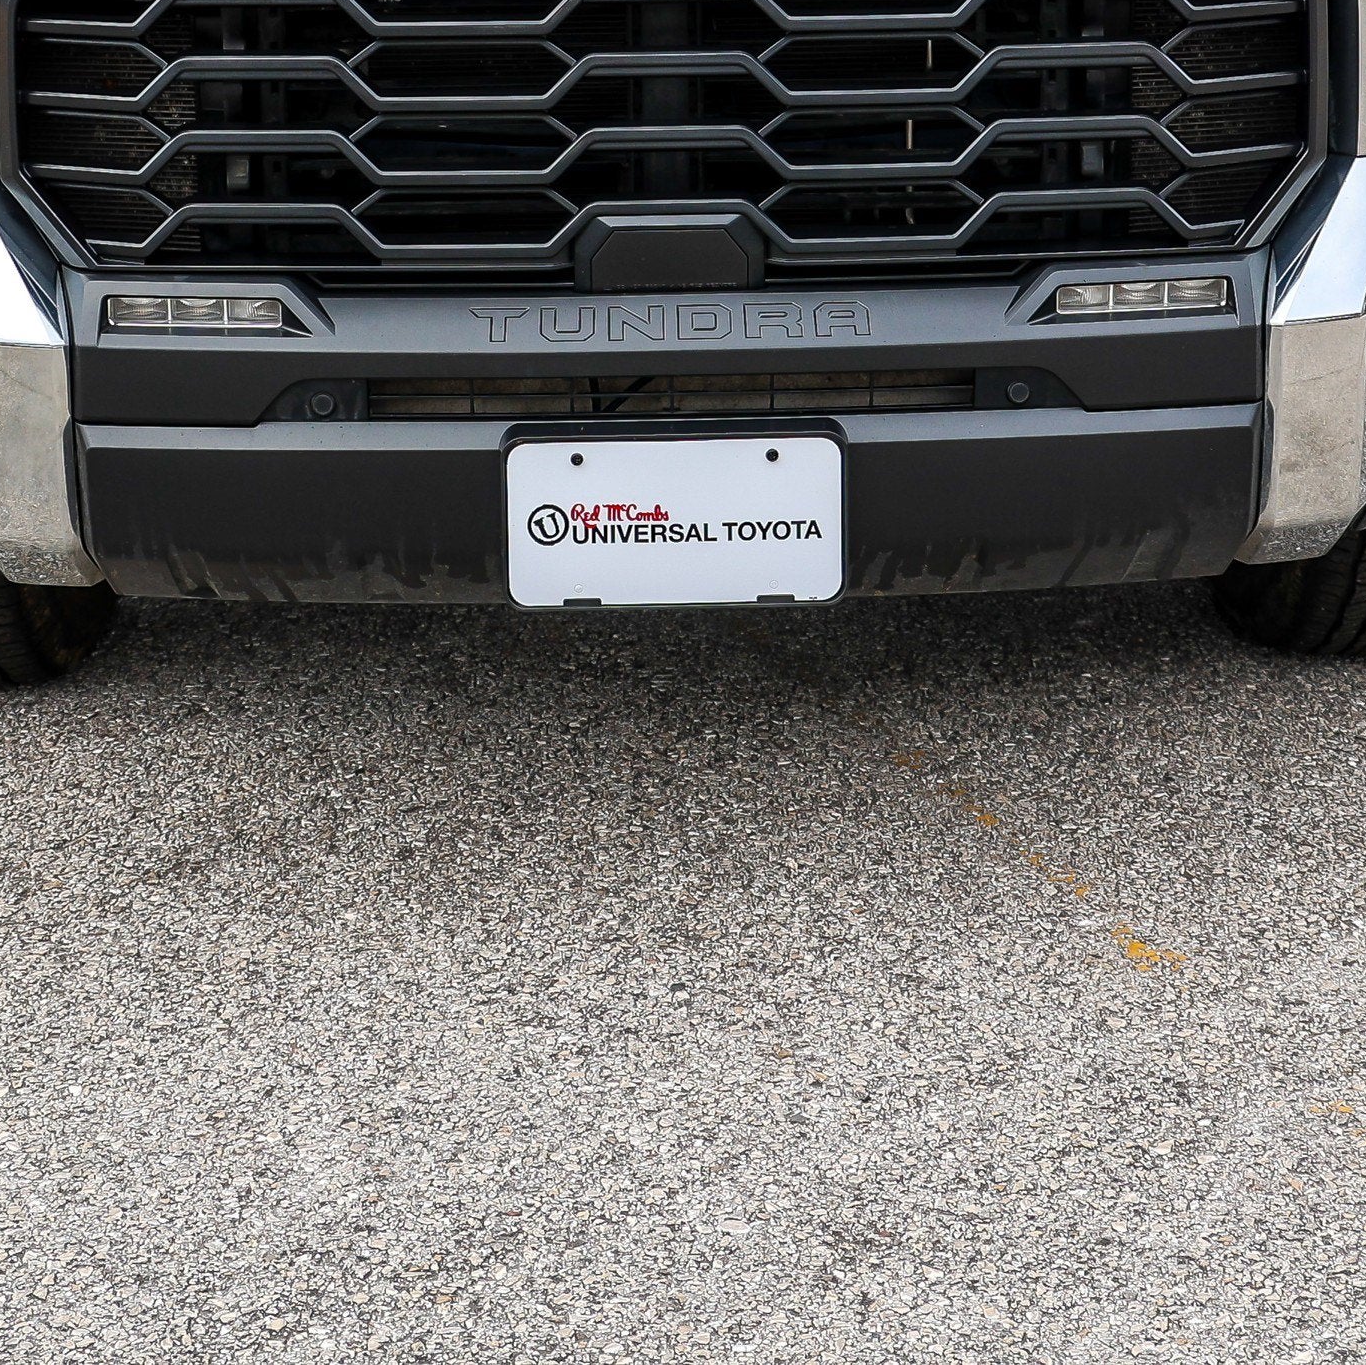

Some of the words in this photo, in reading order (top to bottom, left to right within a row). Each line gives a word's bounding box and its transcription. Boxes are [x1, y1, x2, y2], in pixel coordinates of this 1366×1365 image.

[469, 301, 871, 343] TUNDRA
[571, 504, 600, 529] Red
[603, 504, 669, 522] McCombs
[572, 523, 717, 544] UNIVERSAL
[722, 520, 823, 541] TOYOTA
